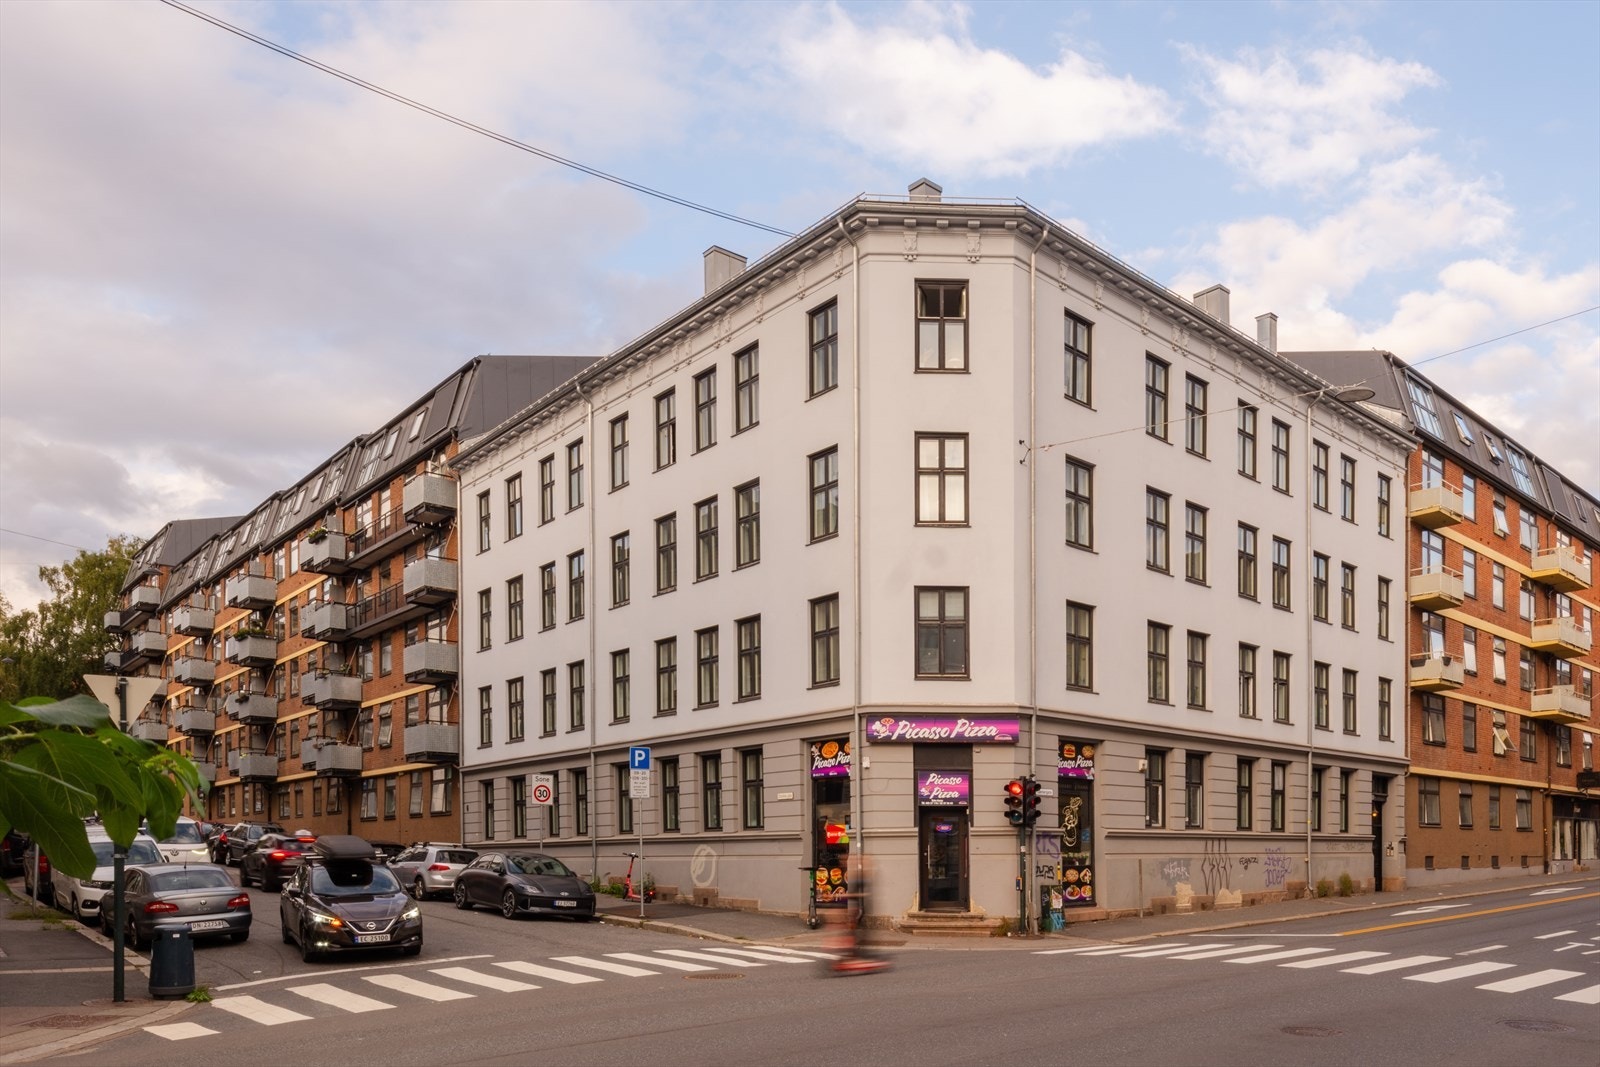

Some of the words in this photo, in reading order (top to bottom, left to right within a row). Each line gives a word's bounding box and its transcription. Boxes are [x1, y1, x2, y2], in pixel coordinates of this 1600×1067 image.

[891, 720, 950, 740] Picasso
[950, 718, 1000, 738] Pizza
[634, 750, 646, 767] P
[812, 756, 836, 770] Picasso
[835, 751, 850, 766] Pizz
[1075, 755, 1093, 768] Pizza
[926, 773, 962, 785] Picasso
[537, 789, 548, 798] 30
[929, 787, 960, 799] Pizza
